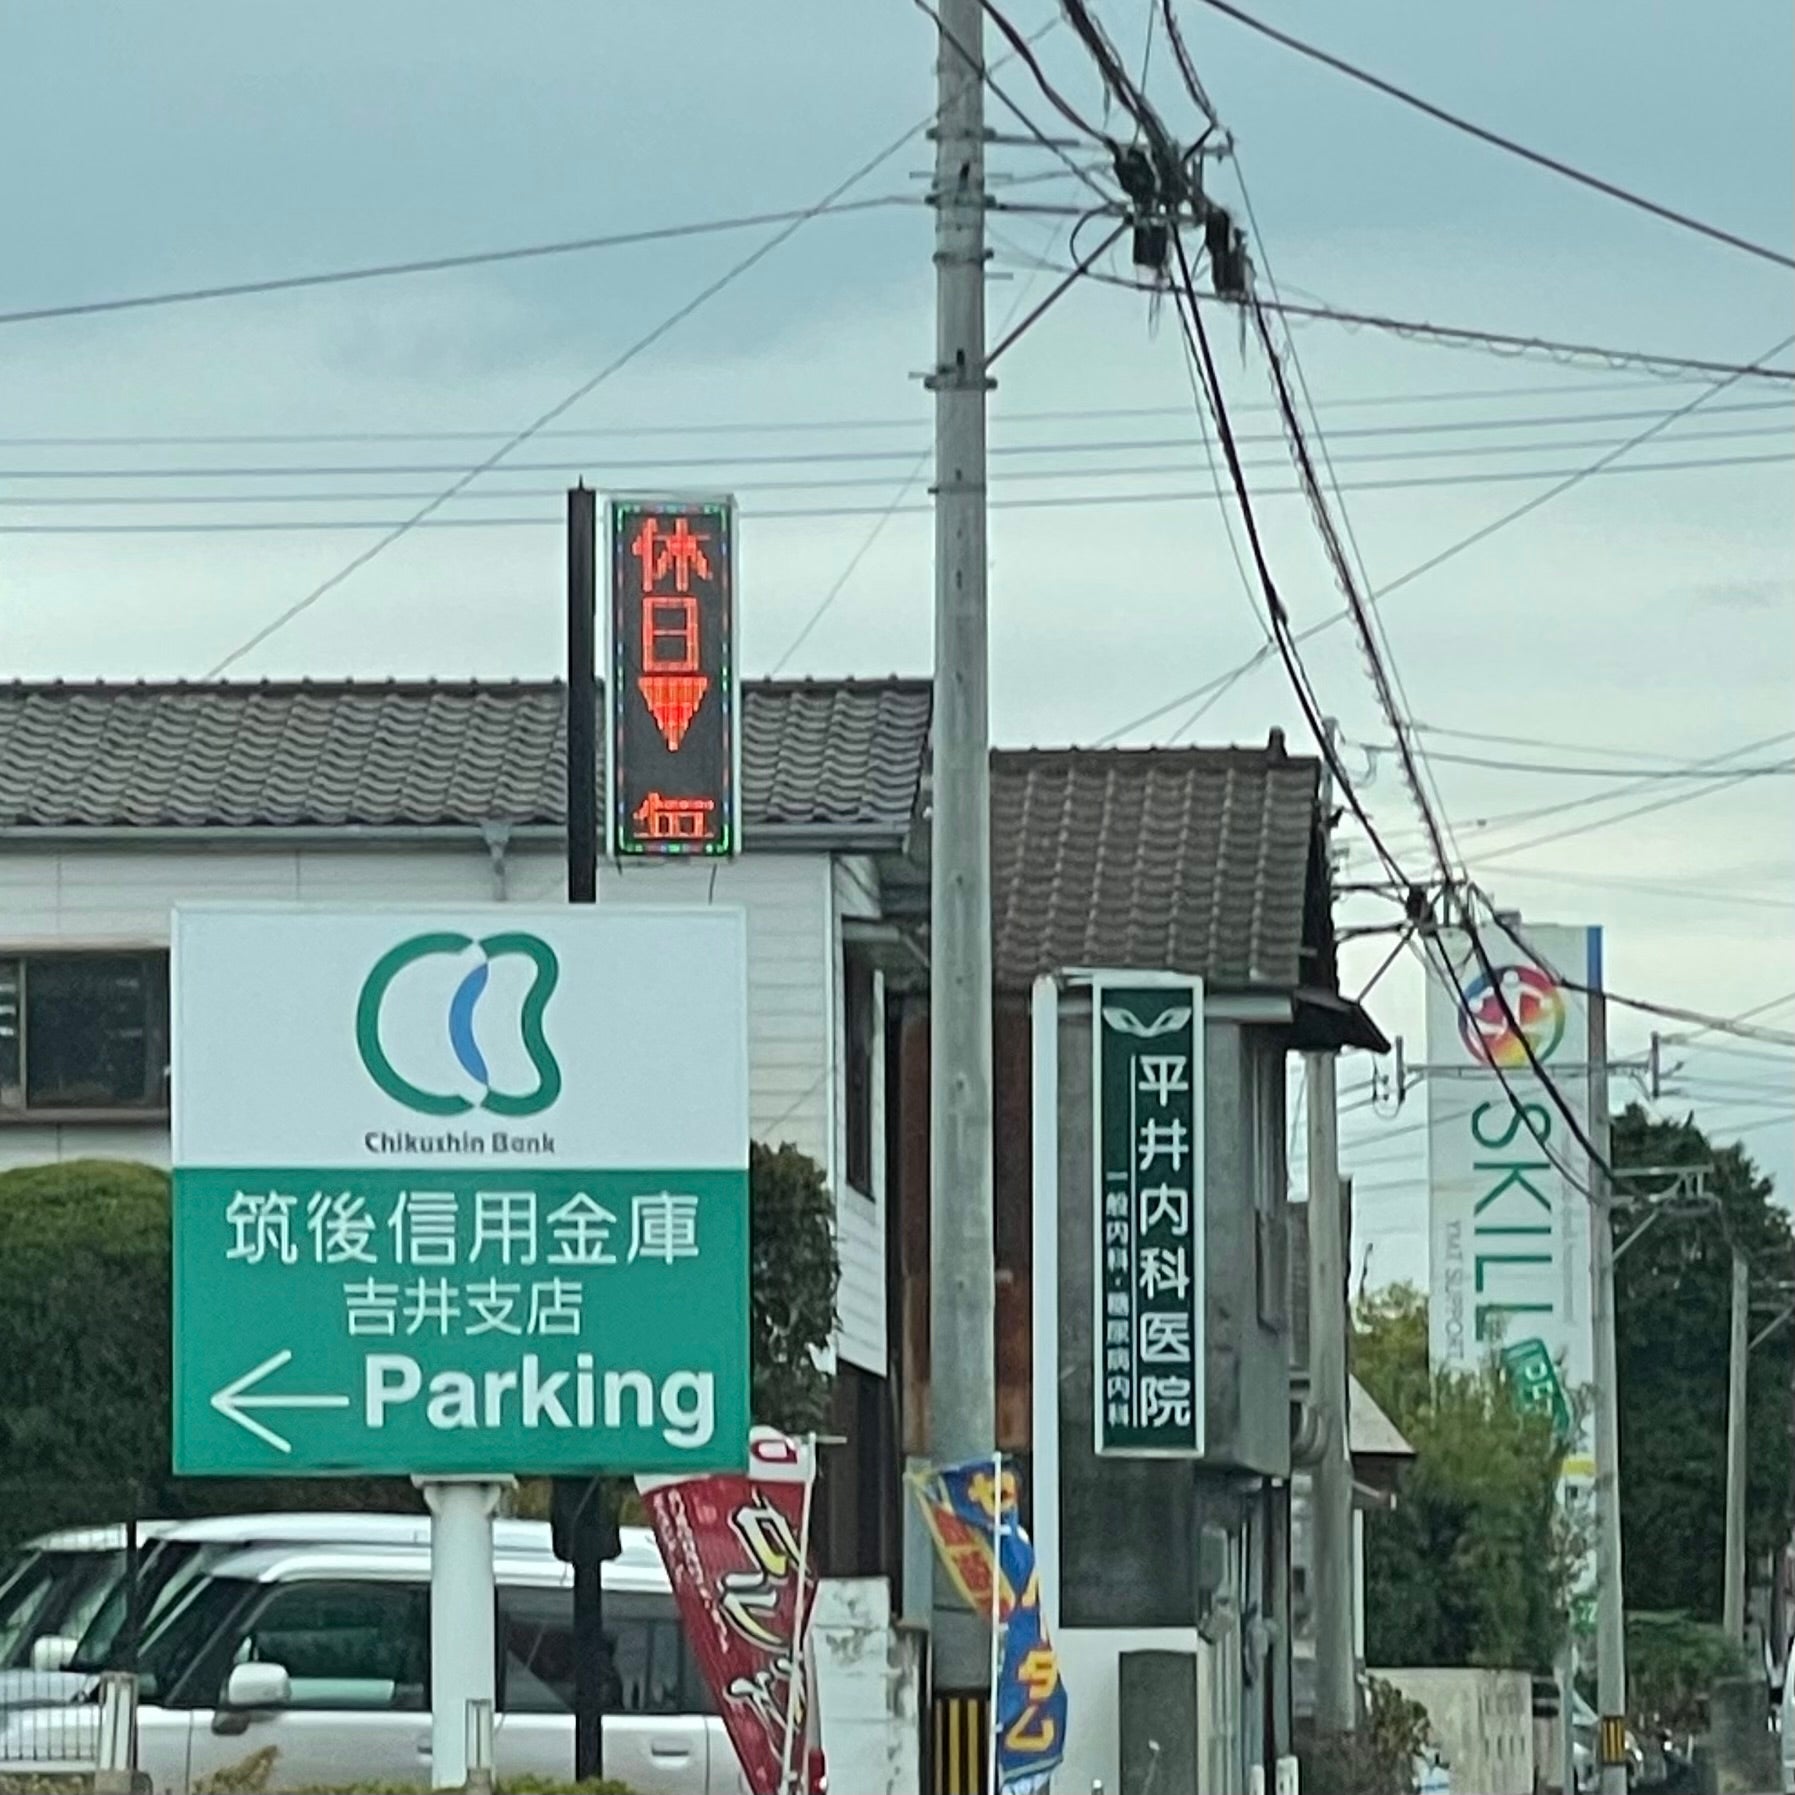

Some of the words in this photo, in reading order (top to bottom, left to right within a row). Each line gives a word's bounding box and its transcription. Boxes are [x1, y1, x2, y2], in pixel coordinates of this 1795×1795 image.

[631, 517, 713, 673] 休日
[364, 1131, 485, 1155] Chikushin
[491, 1131, 556, 1155] Bank
[225, 1189, 700, 1265] 筑後信用金庫
[1138, 1055, 1191, 1428] 平井内科医院
[1471, 1100, 1554, 1342] SKILL
[343, 1276, 583, 1336] 吉井支店
[363, 1353, 715, 1449] Parking
